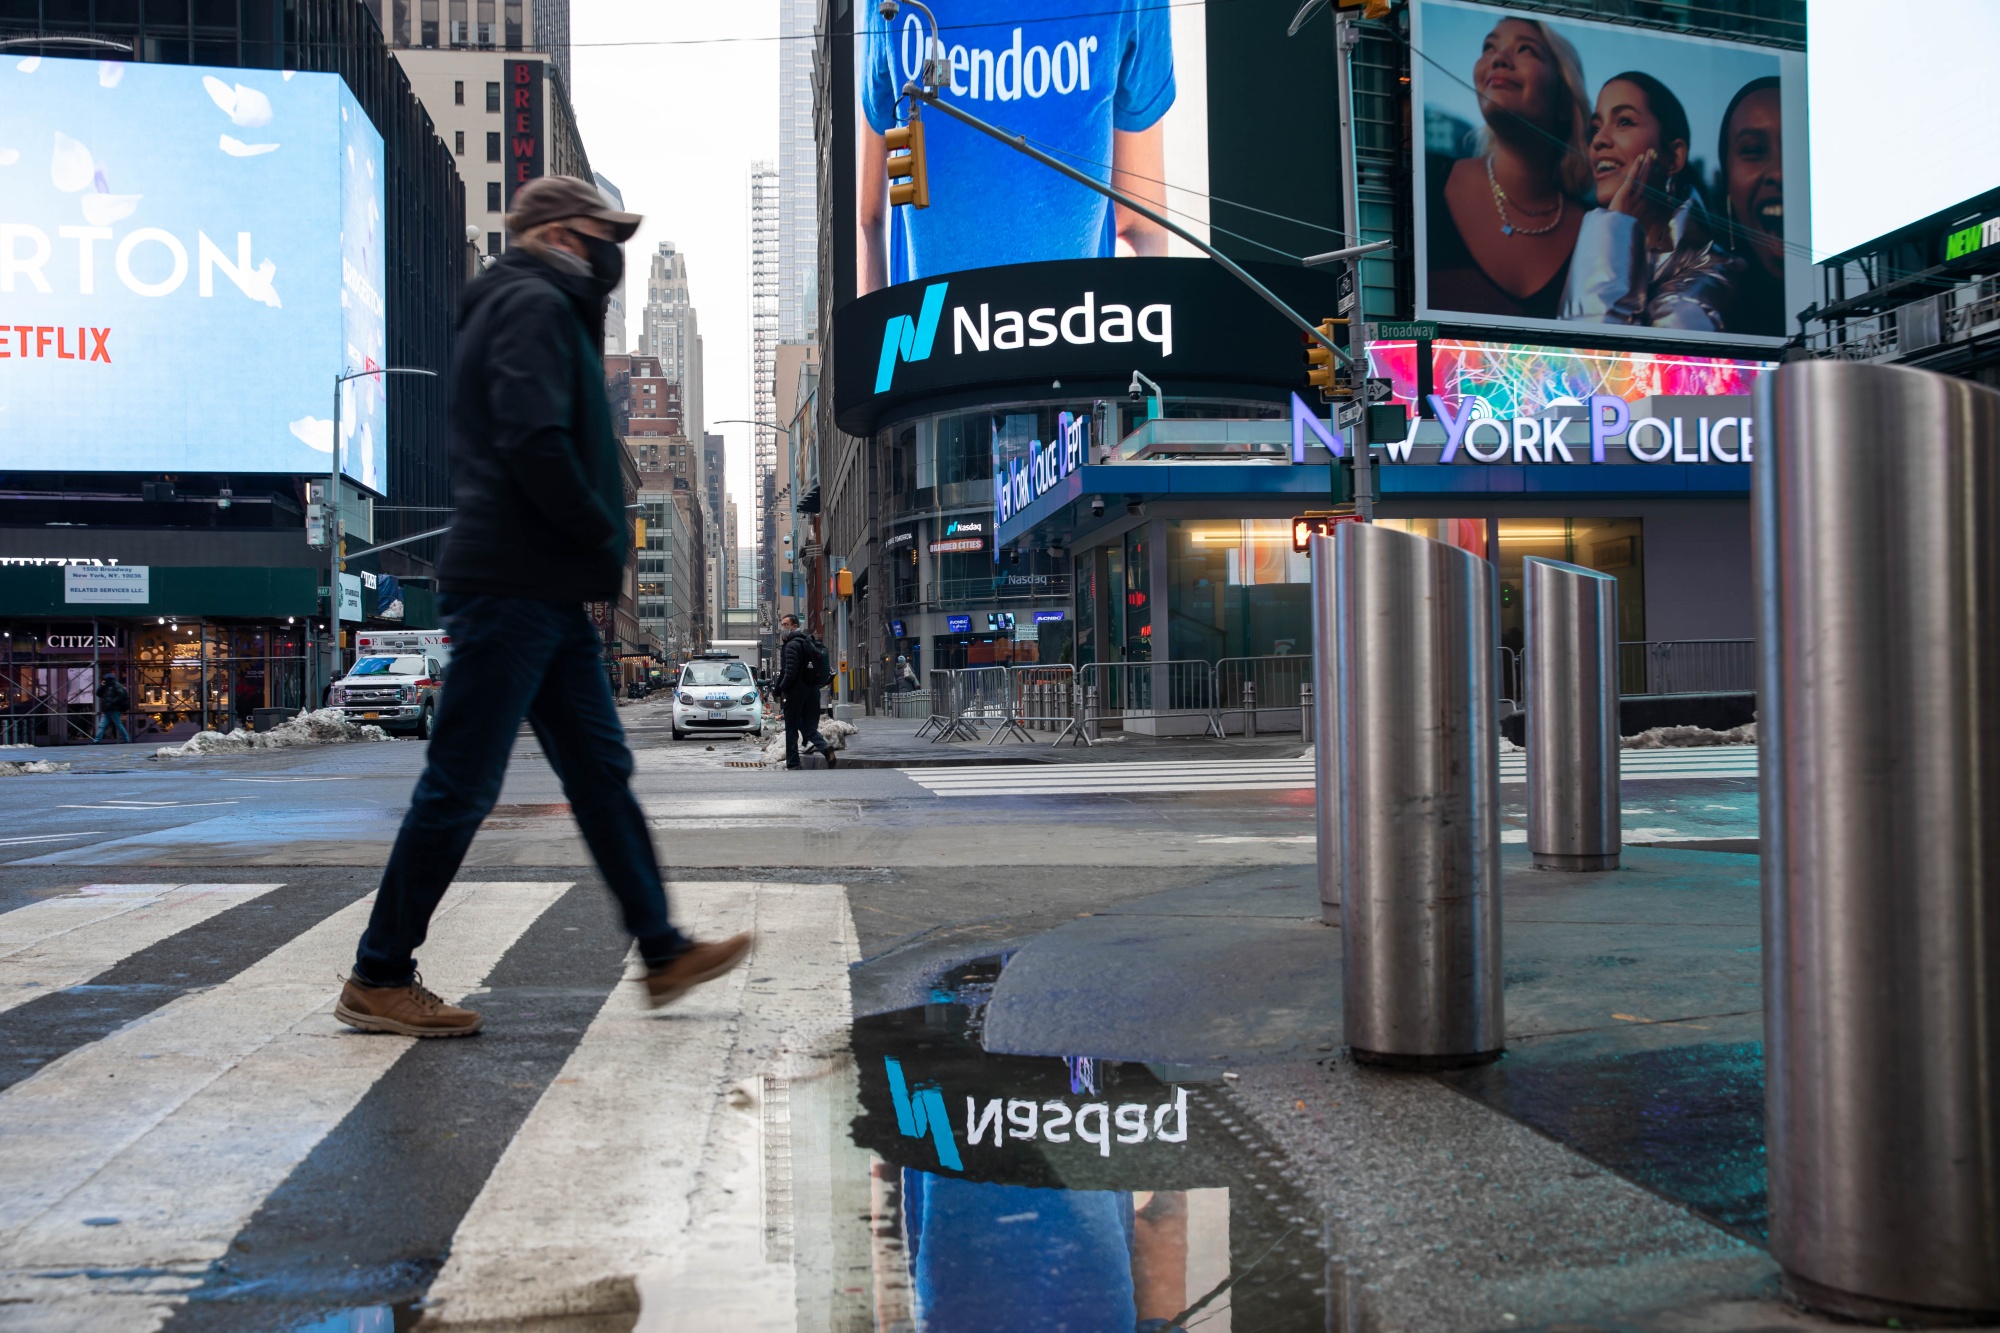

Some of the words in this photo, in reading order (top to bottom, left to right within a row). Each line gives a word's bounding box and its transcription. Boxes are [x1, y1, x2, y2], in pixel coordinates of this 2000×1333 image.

[512, 63, 535, 193] BREWE
[953, 291, 1172, 357] Nasdaq
[1381, 324, 1434, 340] Broadway
[1291, 391, 1421, 463] NW
[1427, 395, 1574, 463] YORK
[1591, 395, 1754, 463] POLICE
[996, 471, 1011, 524] NEW
[1010, 457, 1030, 517] YORK
[1030, 440, 1057, 501] POLICE
[1059, 411, 1083, 479] DEPT
[957, 522, 981, 531] Nasdaq
[930, 542, 956, 552] BRANDED
[958, 540, 981, 550] CITIES
[1008, 575, 1047, 585] Nasdaq
[47, 635, 116, 648] CITIZEN
